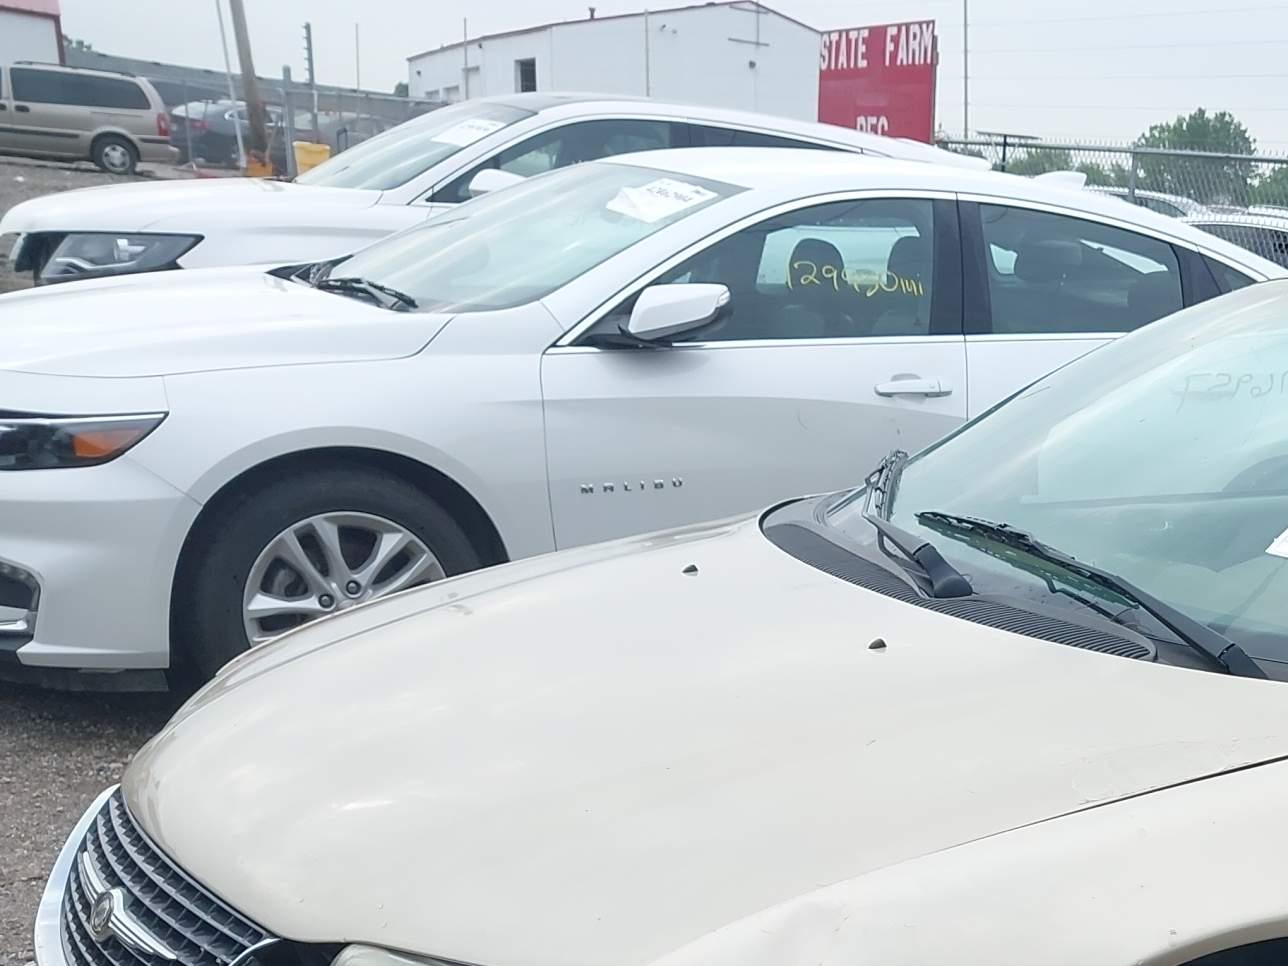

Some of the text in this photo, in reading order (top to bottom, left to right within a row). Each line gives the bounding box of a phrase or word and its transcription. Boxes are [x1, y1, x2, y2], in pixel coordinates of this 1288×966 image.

[820, 22, 934, 71] STATE FARM
[579, 476, 683, 494] MALIBU
